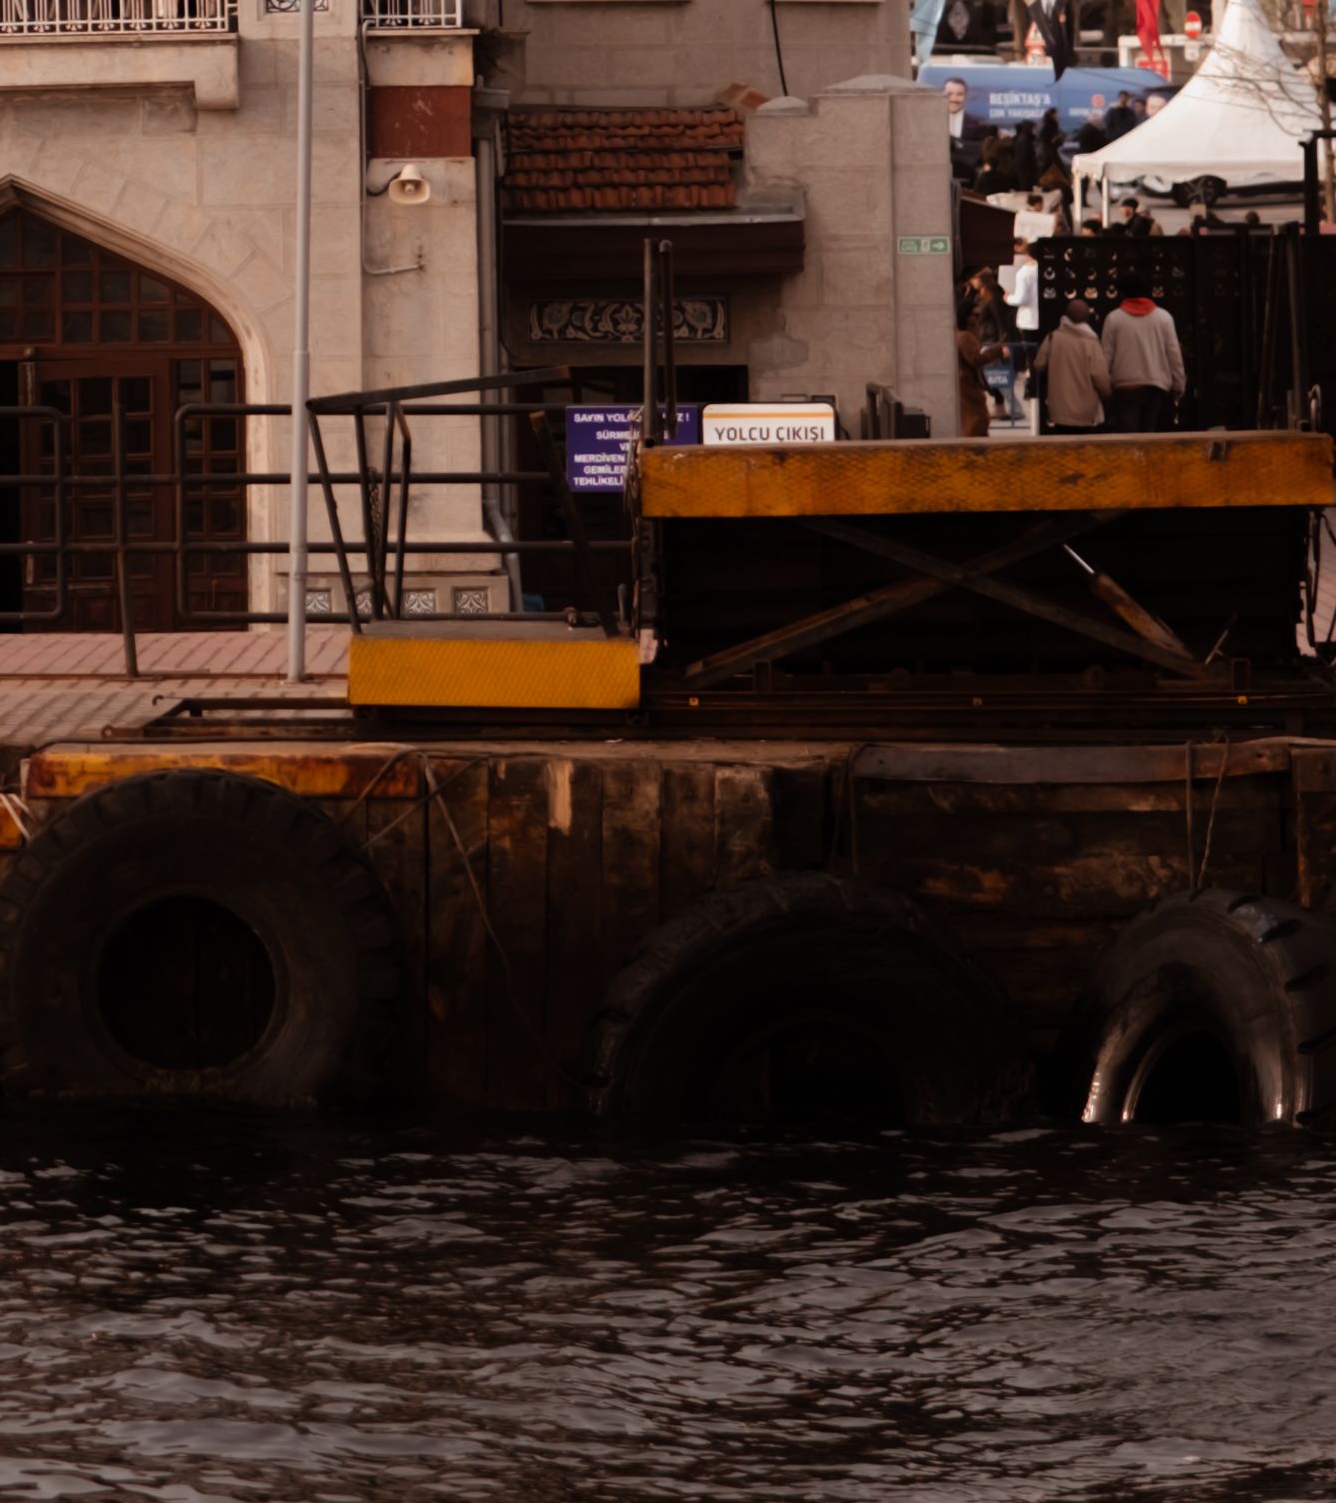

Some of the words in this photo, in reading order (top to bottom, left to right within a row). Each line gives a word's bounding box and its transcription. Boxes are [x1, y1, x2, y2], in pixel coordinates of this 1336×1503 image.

[574, 413, 604, 422] SAYIN
[715, 428, 770, 442] YOLCU
[776, 427, 825, 443] ÇIKIŞI
[574, 453, 625, 463] MERDİVEN
[574, 476, 623, 486] TEHLİKELİ
